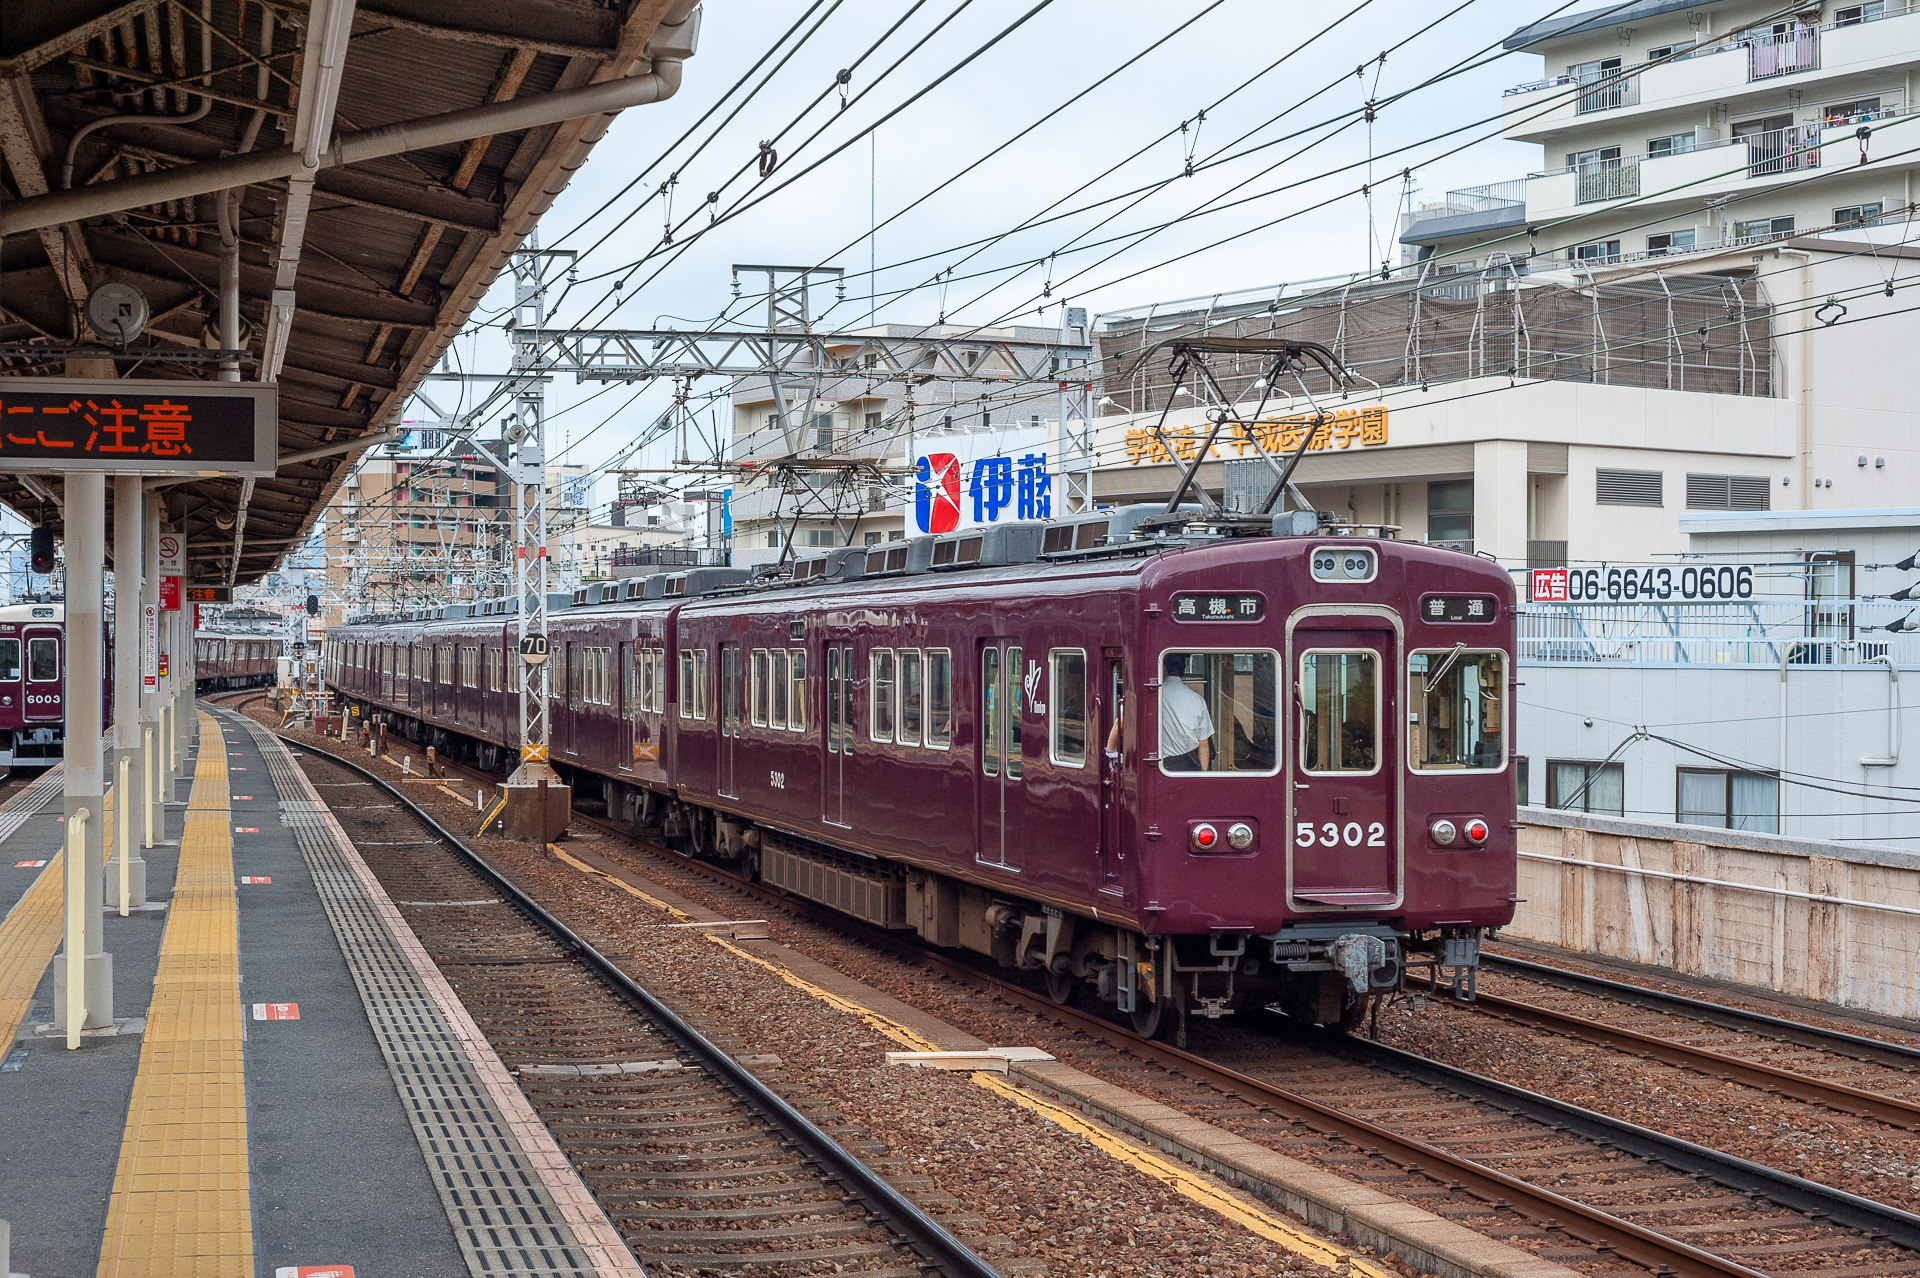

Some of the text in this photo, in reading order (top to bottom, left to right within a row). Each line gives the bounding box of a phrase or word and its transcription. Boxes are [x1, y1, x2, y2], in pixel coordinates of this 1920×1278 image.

[1534, 566, 1754, 600] 広告 06-6643-0606
[1178, 598, 1257, 615] 高槻市
[1429, 599, 1484, 616] 普通
[523, 637, 548, 654] 70
[27, 695, 61, 704] 6003
[770, 770, 785, 789] 5302
[1295, 821, 1386, 848] 5302
